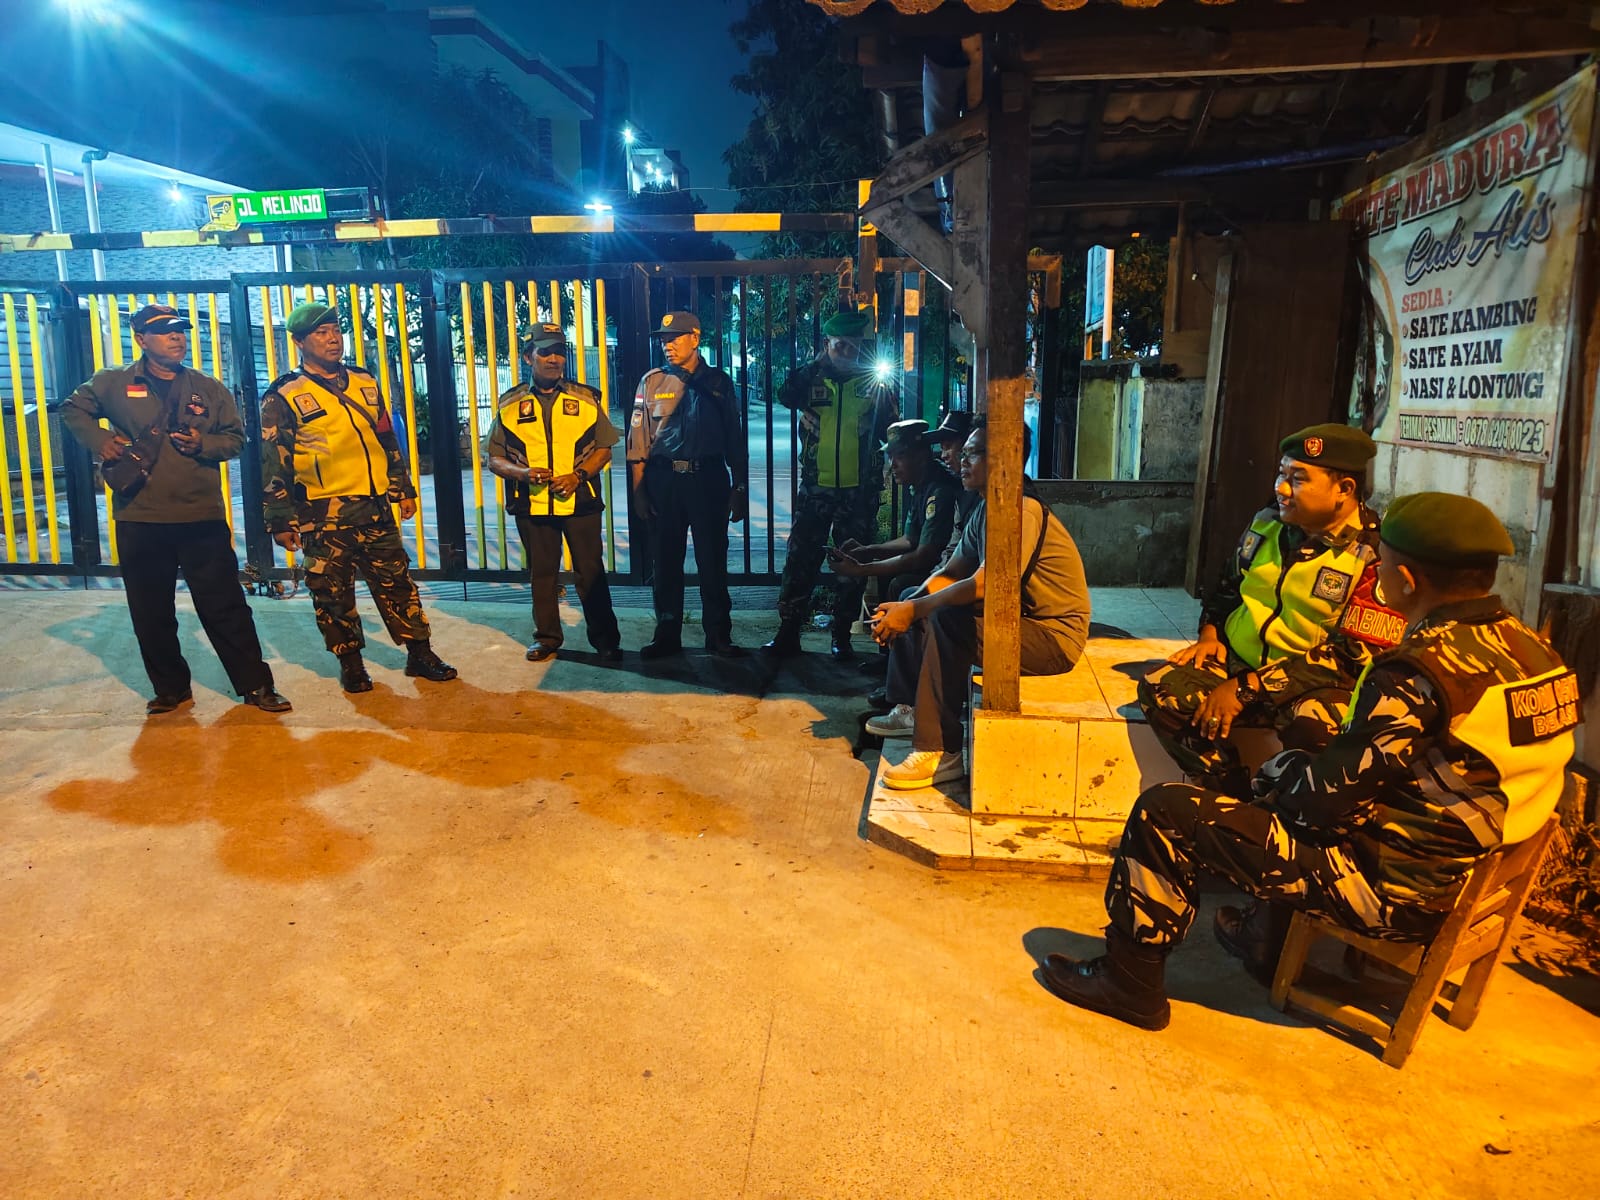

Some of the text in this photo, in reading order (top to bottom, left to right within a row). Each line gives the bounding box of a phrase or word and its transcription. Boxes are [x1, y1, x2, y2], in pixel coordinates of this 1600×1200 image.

[1402, 103, 1567, 226] MADURA
[236, 194, 323, 217] JL MELINJO
[1404, 215, 1467, 286] Cak
[1401, 287, 1445, 314] SEDIA
[1409, 296, 1539, 340] SATE KAMBING
[1408, 339, 1504, 370] SATE AYAM
[1409, 371, 1545, 400] NASI & LONTONG
